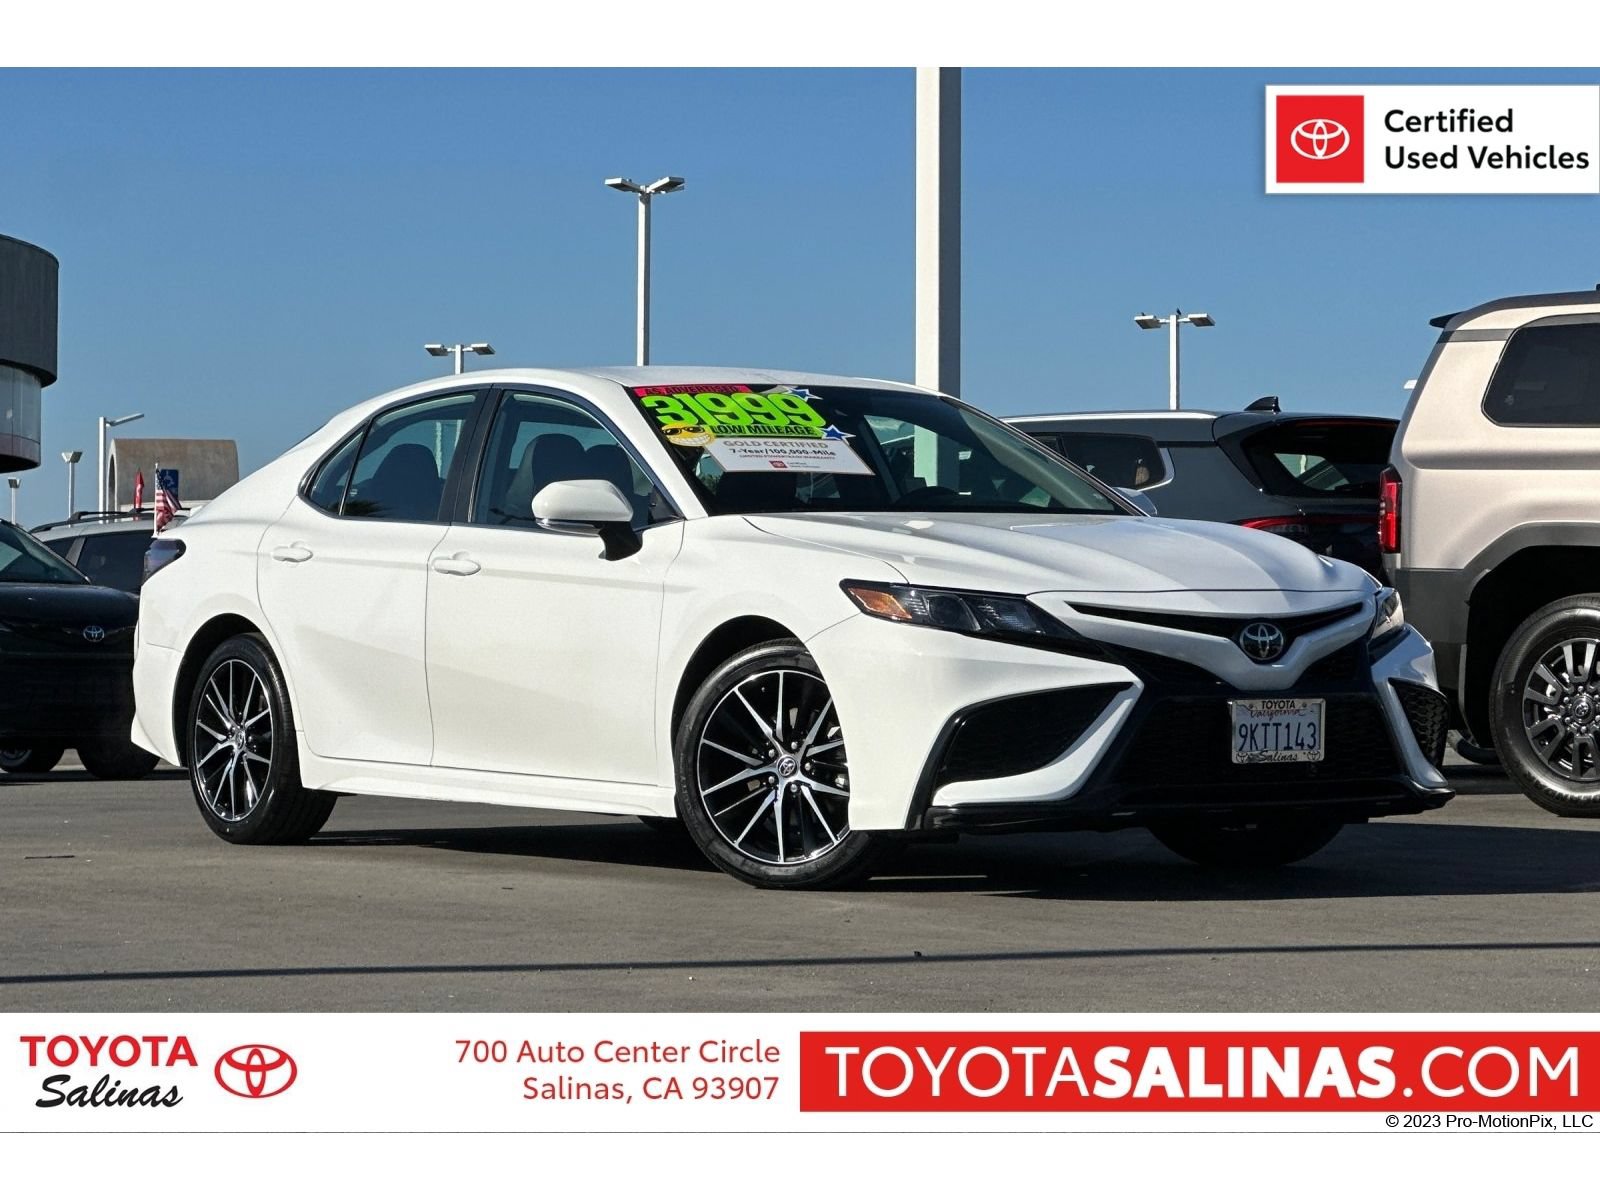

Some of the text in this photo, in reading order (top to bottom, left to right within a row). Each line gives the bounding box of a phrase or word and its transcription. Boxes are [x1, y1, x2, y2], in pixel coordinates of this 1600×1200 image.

[641, 393, 826, 427] 31999
[711, 425, 815, 436] LOW MILEAGE
[722, 440, 829, 449] GOLD CERTIFIED
[1261, 700, 1296, 710] TOYOTA
[1238, 722, 1317, 751] 9KTT143
[1259, 749, 1298, 761] Salinas
